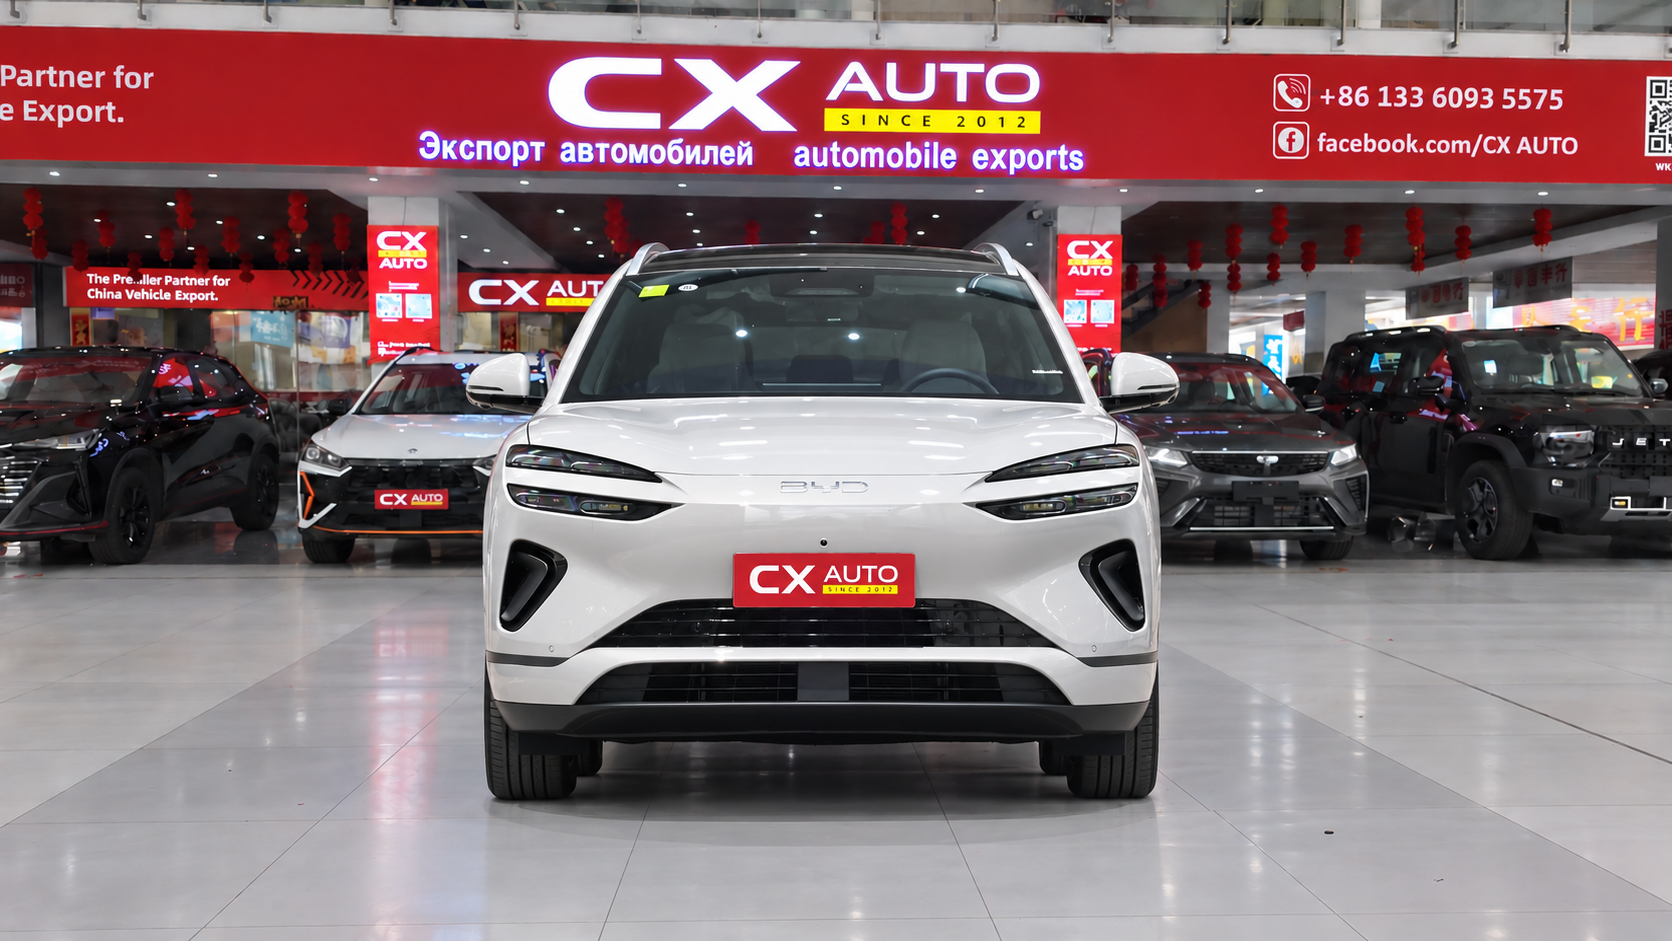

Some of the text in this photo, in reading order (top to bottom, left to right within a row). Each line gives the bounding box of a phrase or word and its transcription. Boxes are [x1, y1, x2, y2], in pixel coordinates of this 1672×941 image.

[0, 64, 154, 89] Partner for
[548, 56, 1041, 132] CX AUTO
[1320, 85, 1563, 111] +86 133 6093 5575
[23, 99, 124, 129] Export.
[841, 113, 1026, 128] SINCE 2012
[418, 130, 753, 167] Экспорт автомобилей
[1317, 132, 1579, 158] facebook.com/CX AUTO
[794, 141, 1084, 175] automobile exports
[376, 231, 427, 251] CX
[1067, 240, 1114, 259] CX
[379, 257, 428, 269] AUTO
[1067, 265, 1113, 276] AUTO
[86, 273, 110, 285] The
[164, 275, 210, 287] Partner
[212, 275, 231, 287] for
[86, 287, 219, 304] China Vehicle Export.
[468, 279, 604, 306] CX AUT
[780, 481, 869, 493] BYD
[379, 493, 444, 506] CX AUTO
[749, 565, 899, 594] CX AUTO
